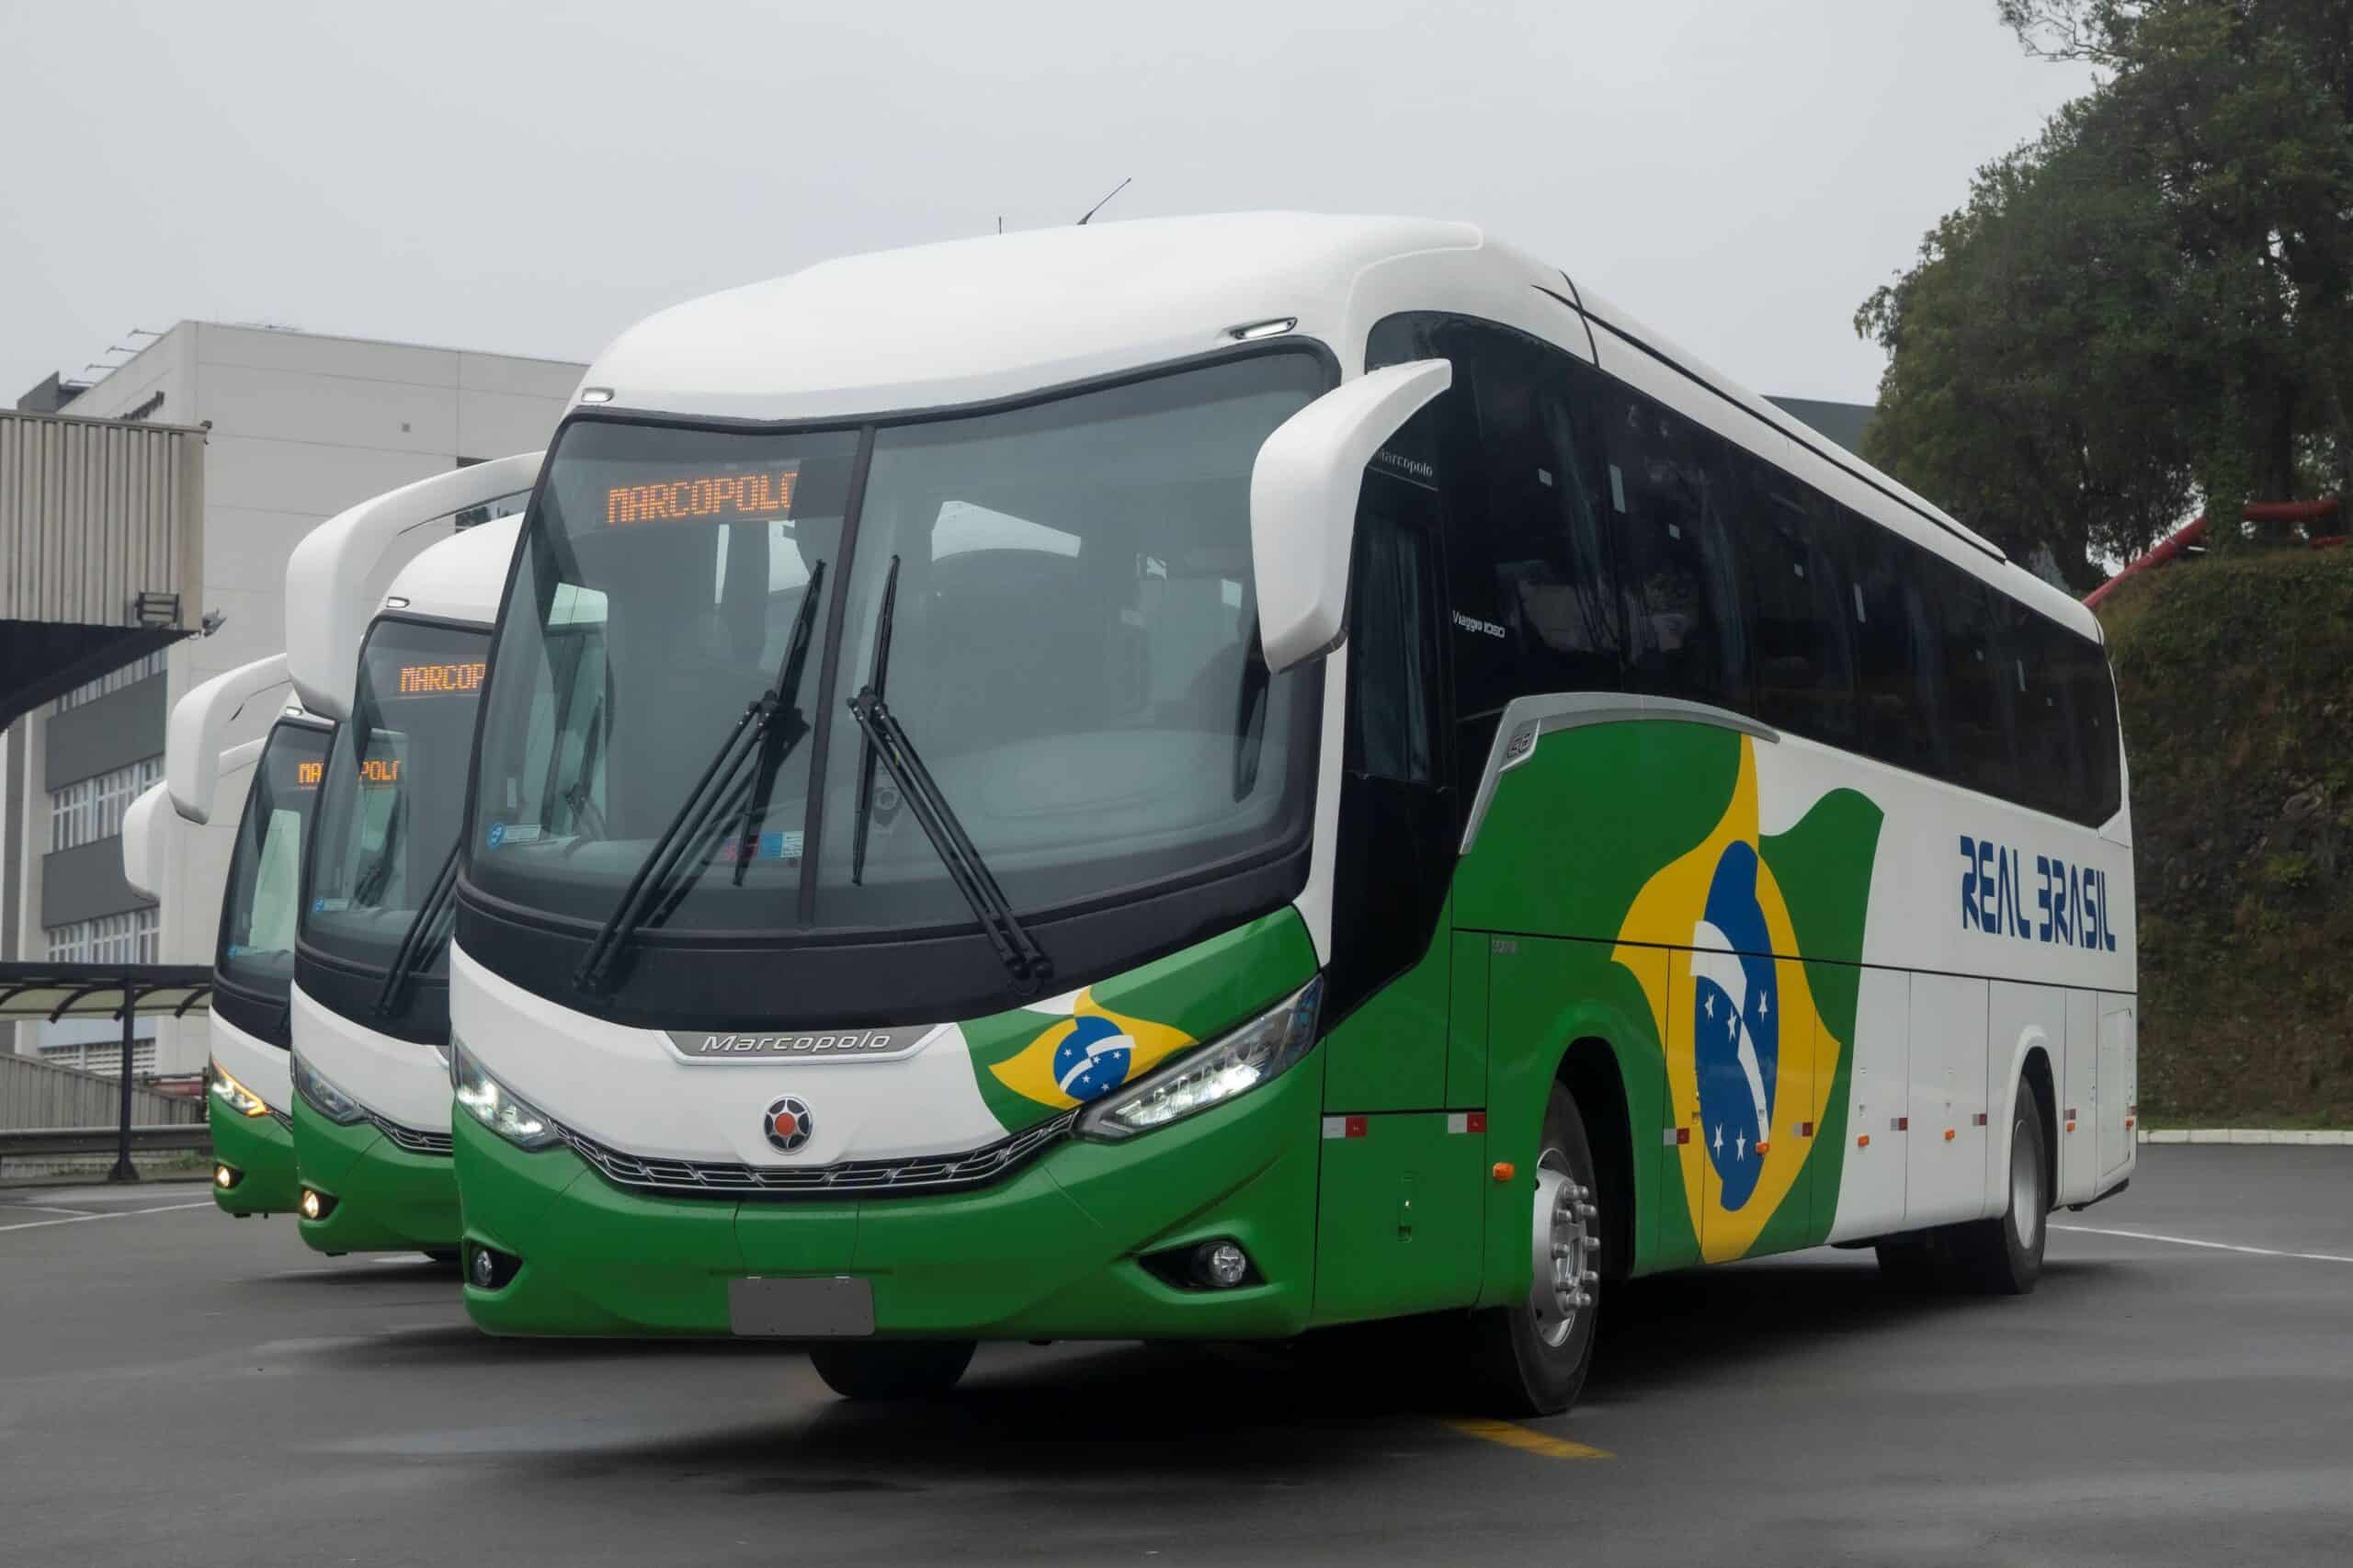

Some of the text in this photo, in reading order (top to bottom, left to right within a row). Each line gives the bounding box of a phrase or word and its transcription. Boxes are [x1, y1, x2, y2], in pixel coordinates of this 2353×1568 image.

[1960, 835, 2116, 952] REAL BRASIL
[699, 1030, 891, 1053] Marcopolo
